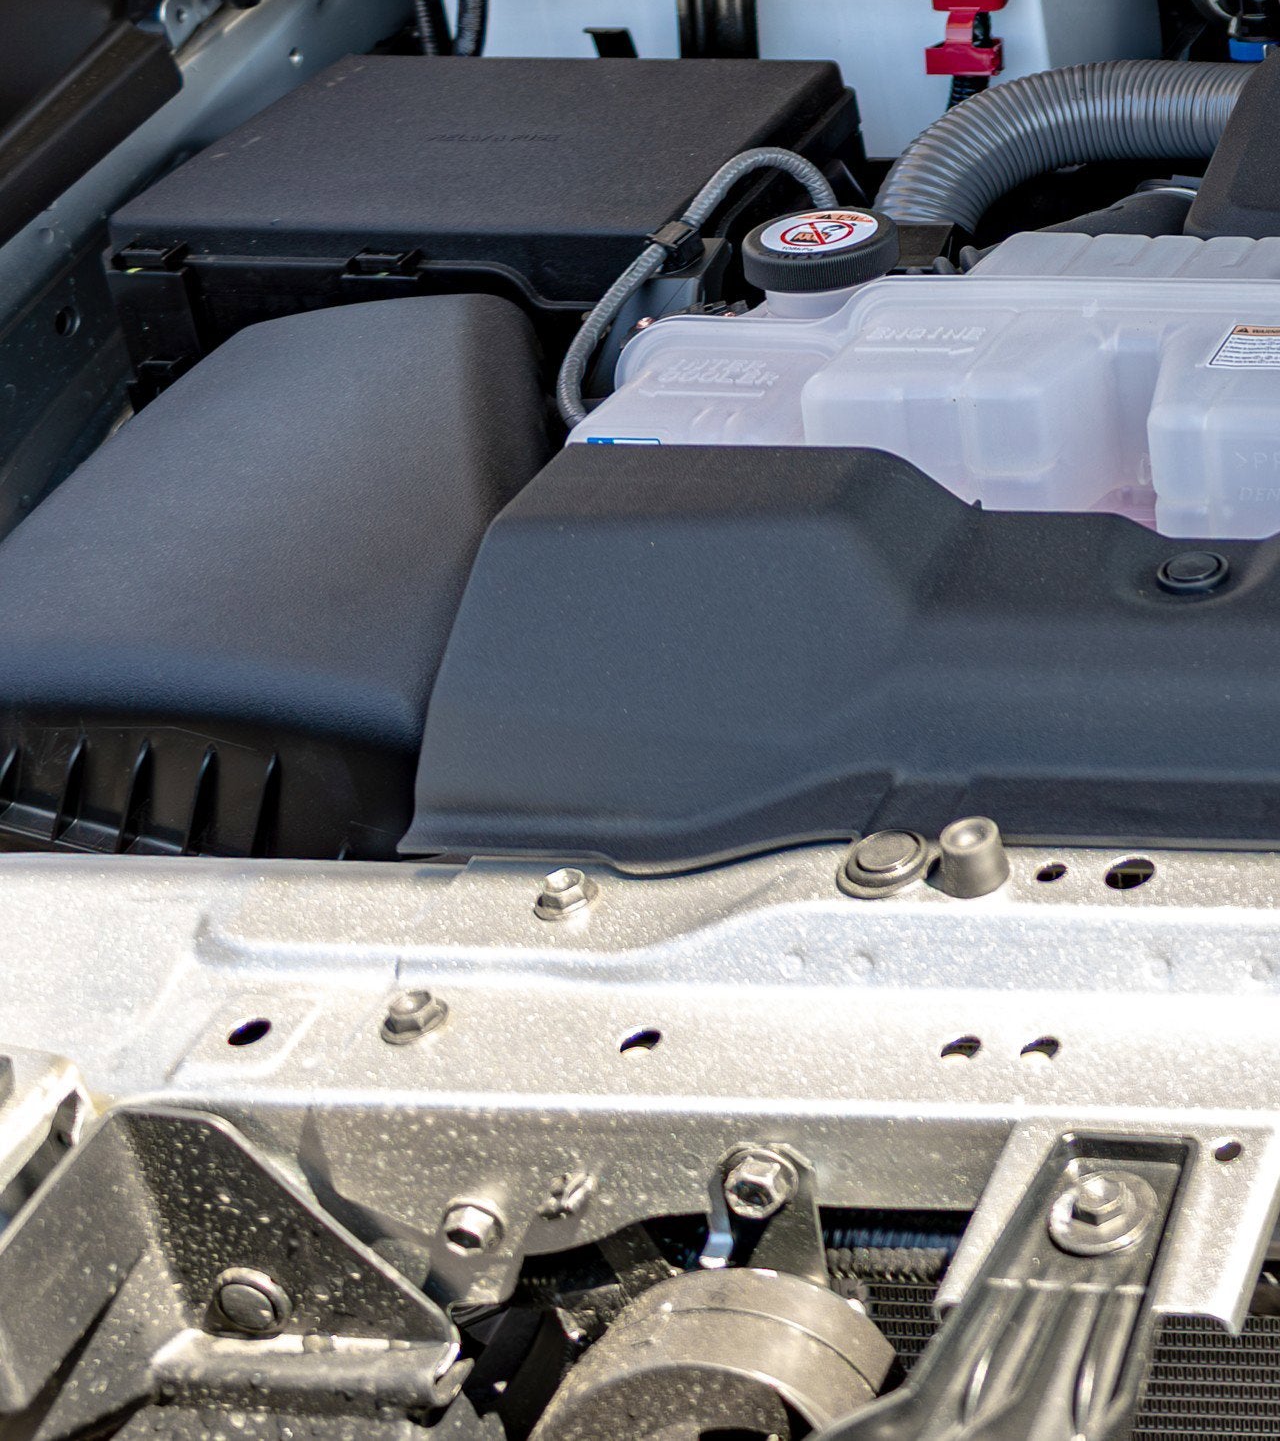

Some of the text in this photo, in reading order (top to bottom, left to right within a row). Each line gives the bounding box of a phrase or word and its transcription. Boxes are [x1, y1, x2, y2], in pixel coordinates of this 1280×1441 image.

[866, 326, 986, 342] ENGINE
[669, 358, 768, 372] INTER
[658, 371, 780, 387] COOLER
